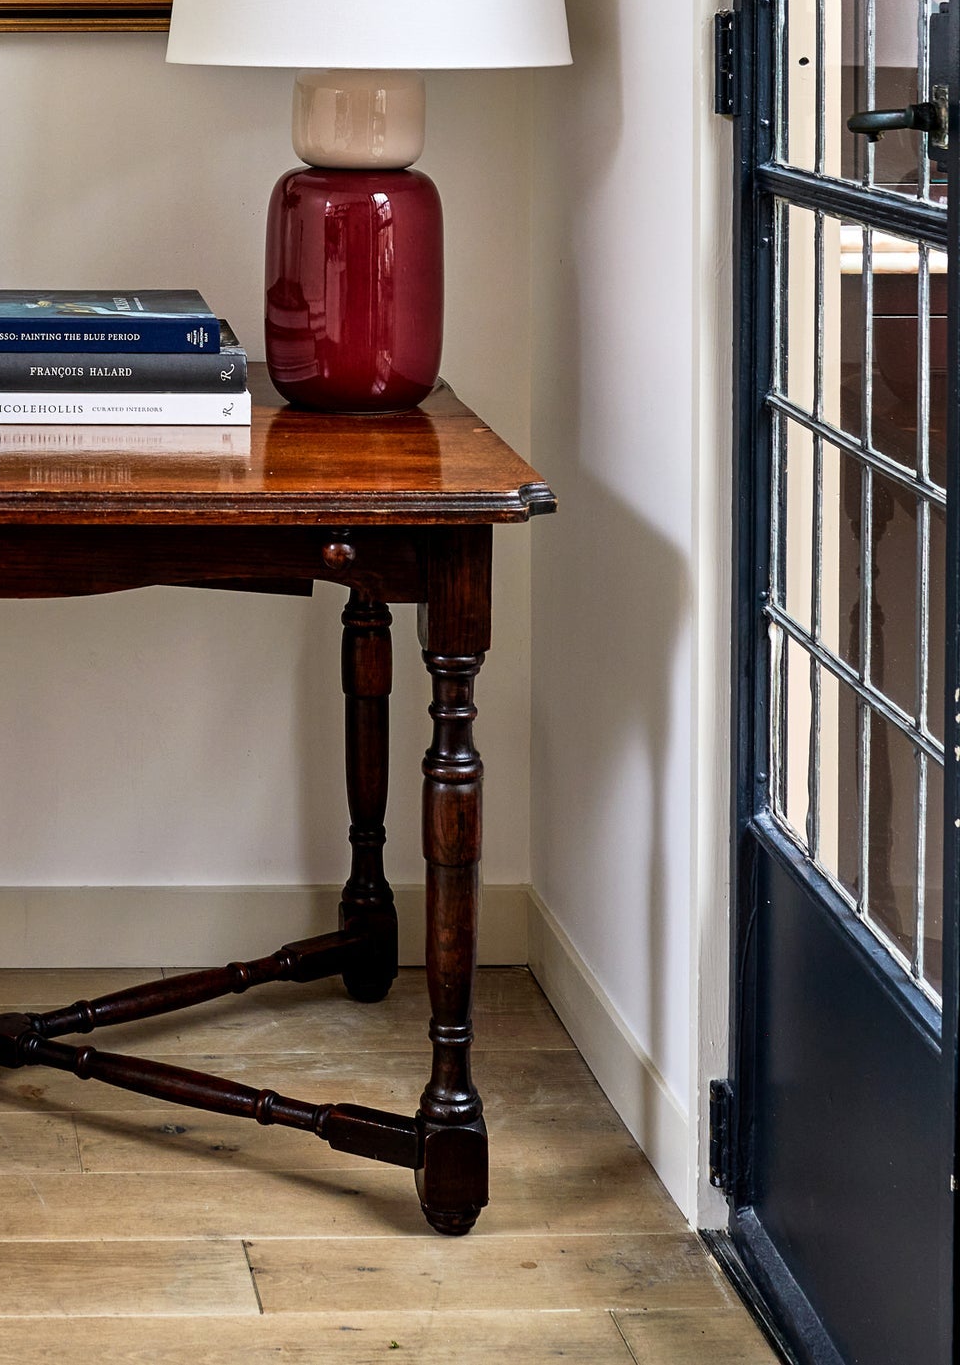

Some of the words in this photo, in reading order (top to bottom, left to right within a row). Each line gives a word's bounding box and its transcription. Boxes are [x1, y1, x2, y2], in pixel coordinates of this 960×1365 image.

[20, 332, 62, 341] PAINTING
[63, 333, 82, 341] THE
[83, 333, 106, 341] BLUE
[107, 333, 141, 341] PERIOD
[29, 366, 84, 379] FRANÇOIS
[89, 367, 132, 377] HALARD
